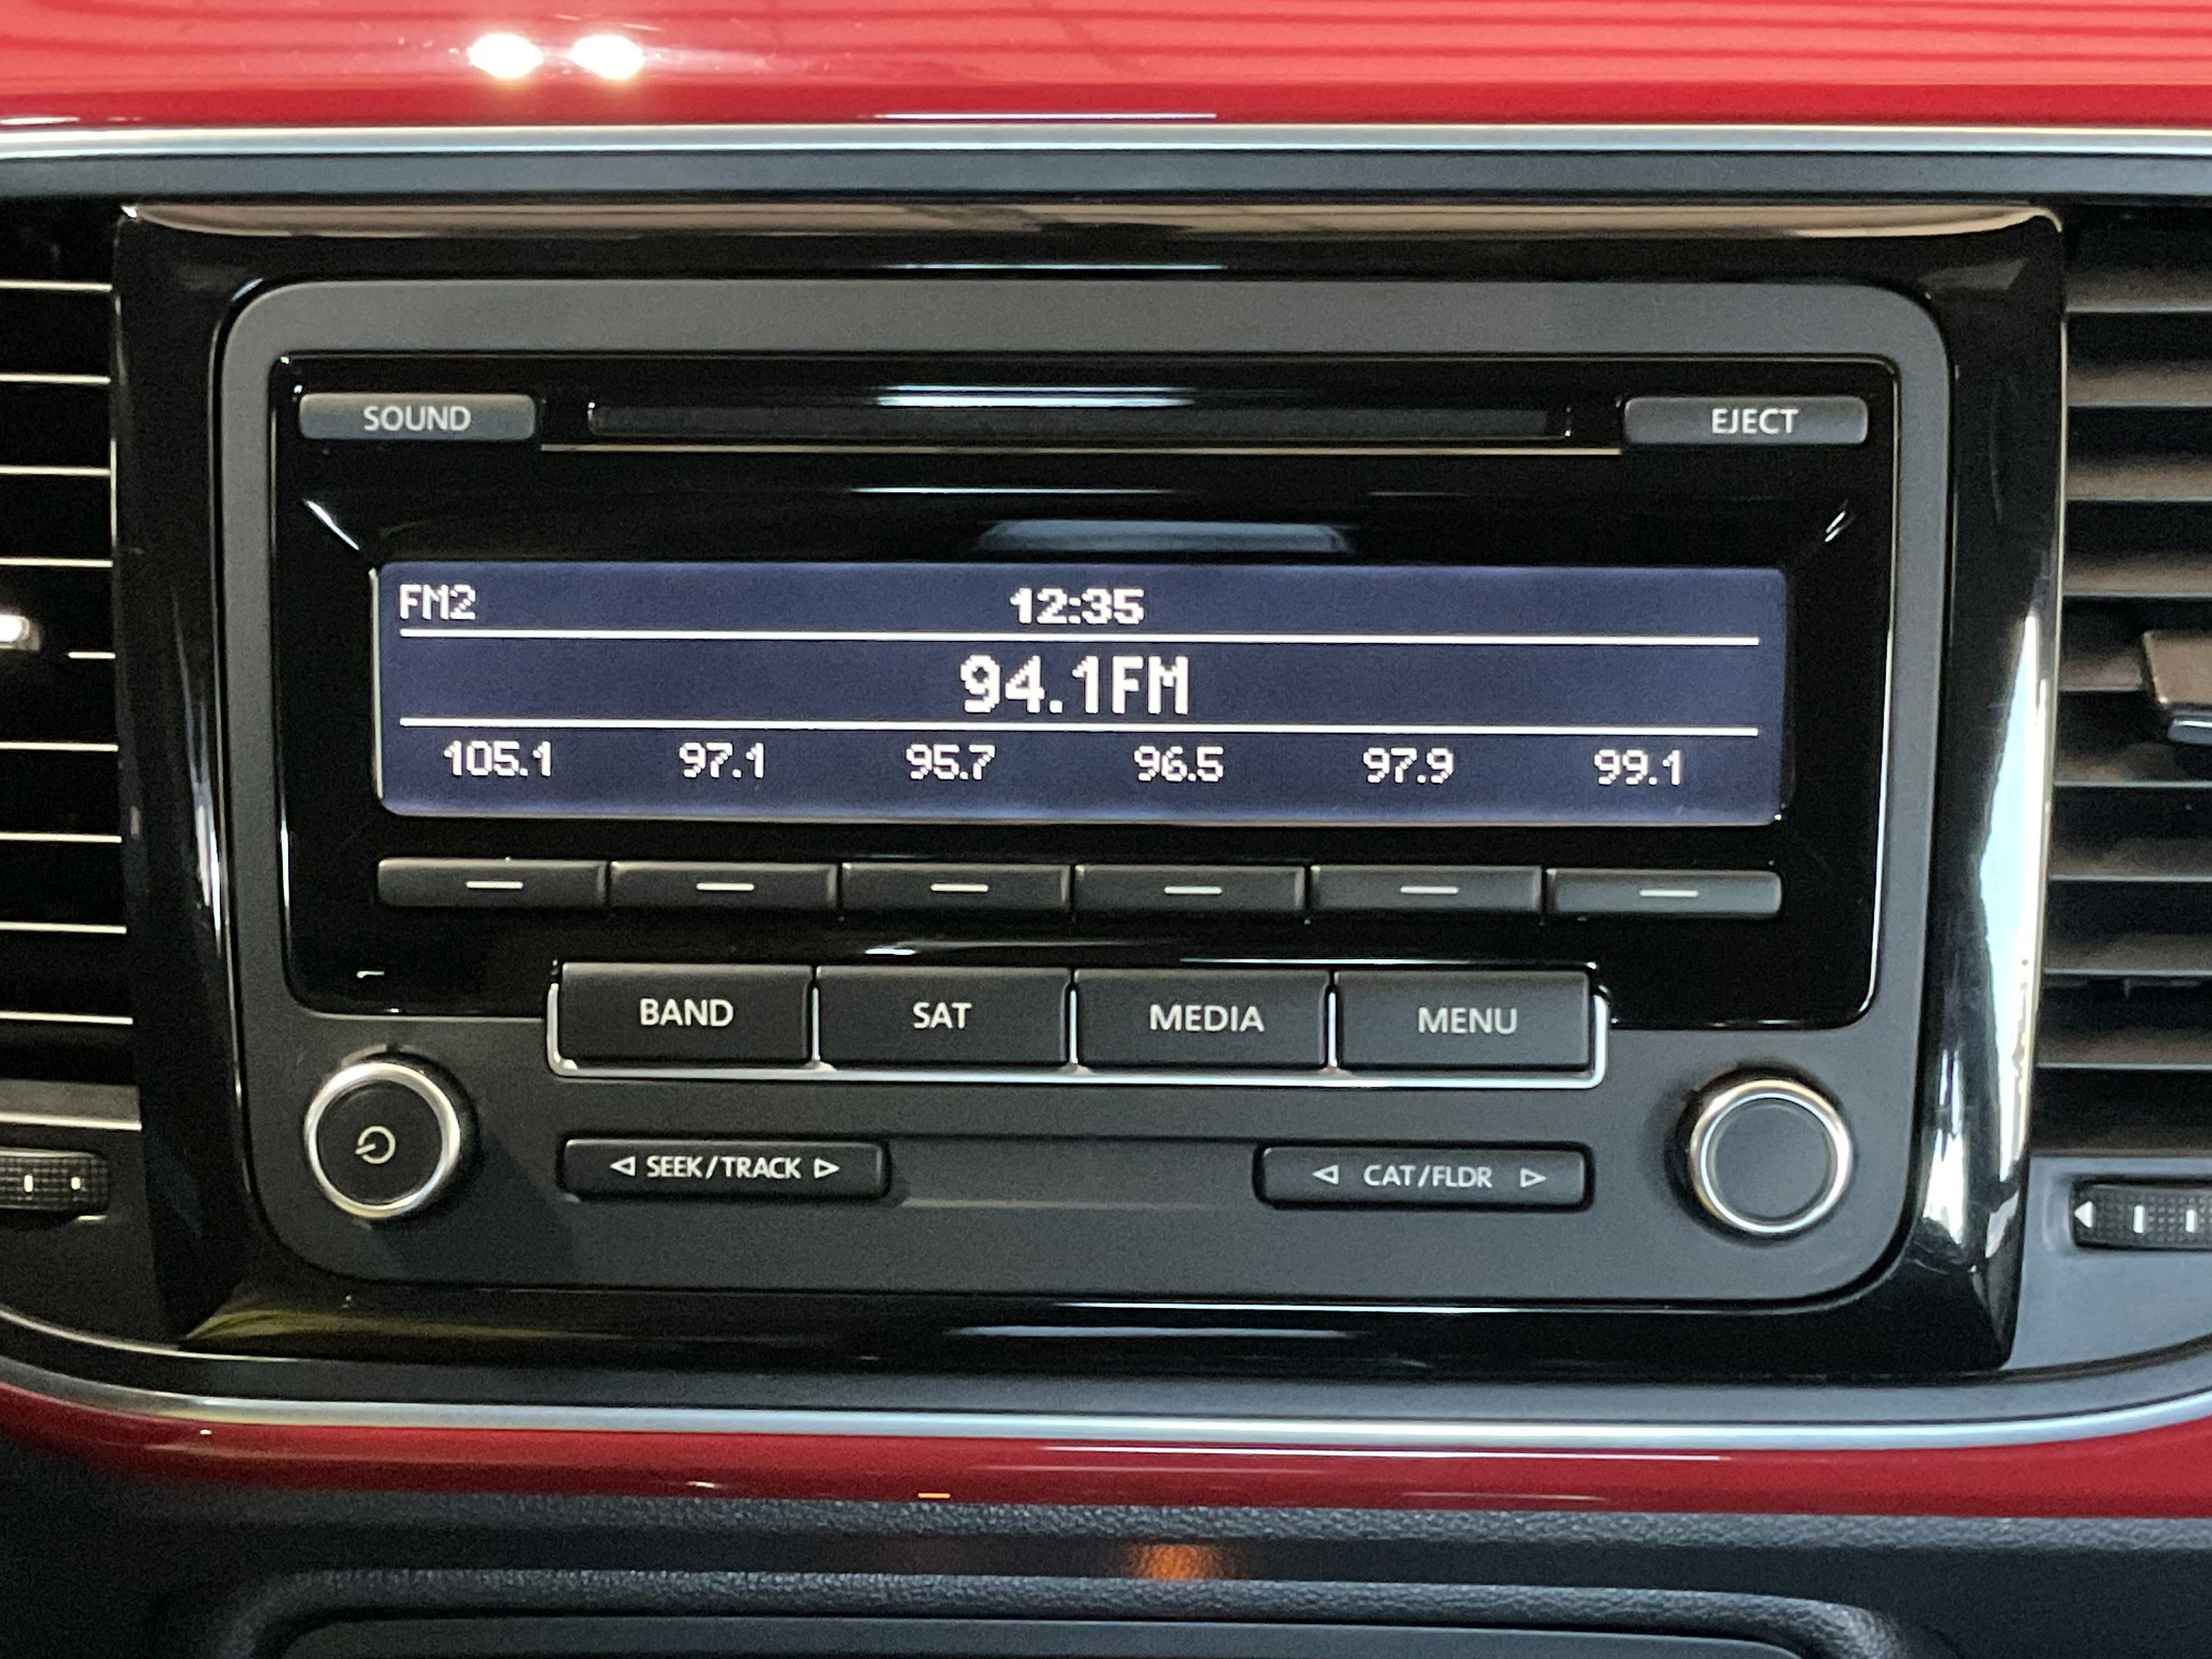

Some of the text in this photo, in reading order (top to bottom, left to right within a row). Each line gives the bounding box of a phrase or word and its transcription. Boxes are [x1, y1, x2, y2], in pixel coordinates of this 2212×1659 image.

[363, 405, 471, 431] SOUND
[1712, 408, 1799, 435] EJECT
[399, 583, 476, 620] FM2
[1009, 587, 1144, 625] 12:35
[960, 654, 1189, 715] 94.1FM
[443, 740, 551, 777] 105.1
[679, 742, 764, 778] 97.1
[906, 743, 996, 780] 95.7
[1133, 745, 1224, 782] 96.5
[1363, 747, 1454, 784] 97.9
[1594, 749, 1681, 786] 99.1
[640, 998, 734, 1027] BAND
[913, 1001, 972, 1029] SAT
[1150, 1004, 1265, 1032] MEDIA
[1418, 1007, 1517, 1035] MENU
[646, 1155, 802, 1180] SEEK/TRACK
[1363, 1164, 1493, 1188] CAT/FLDR
